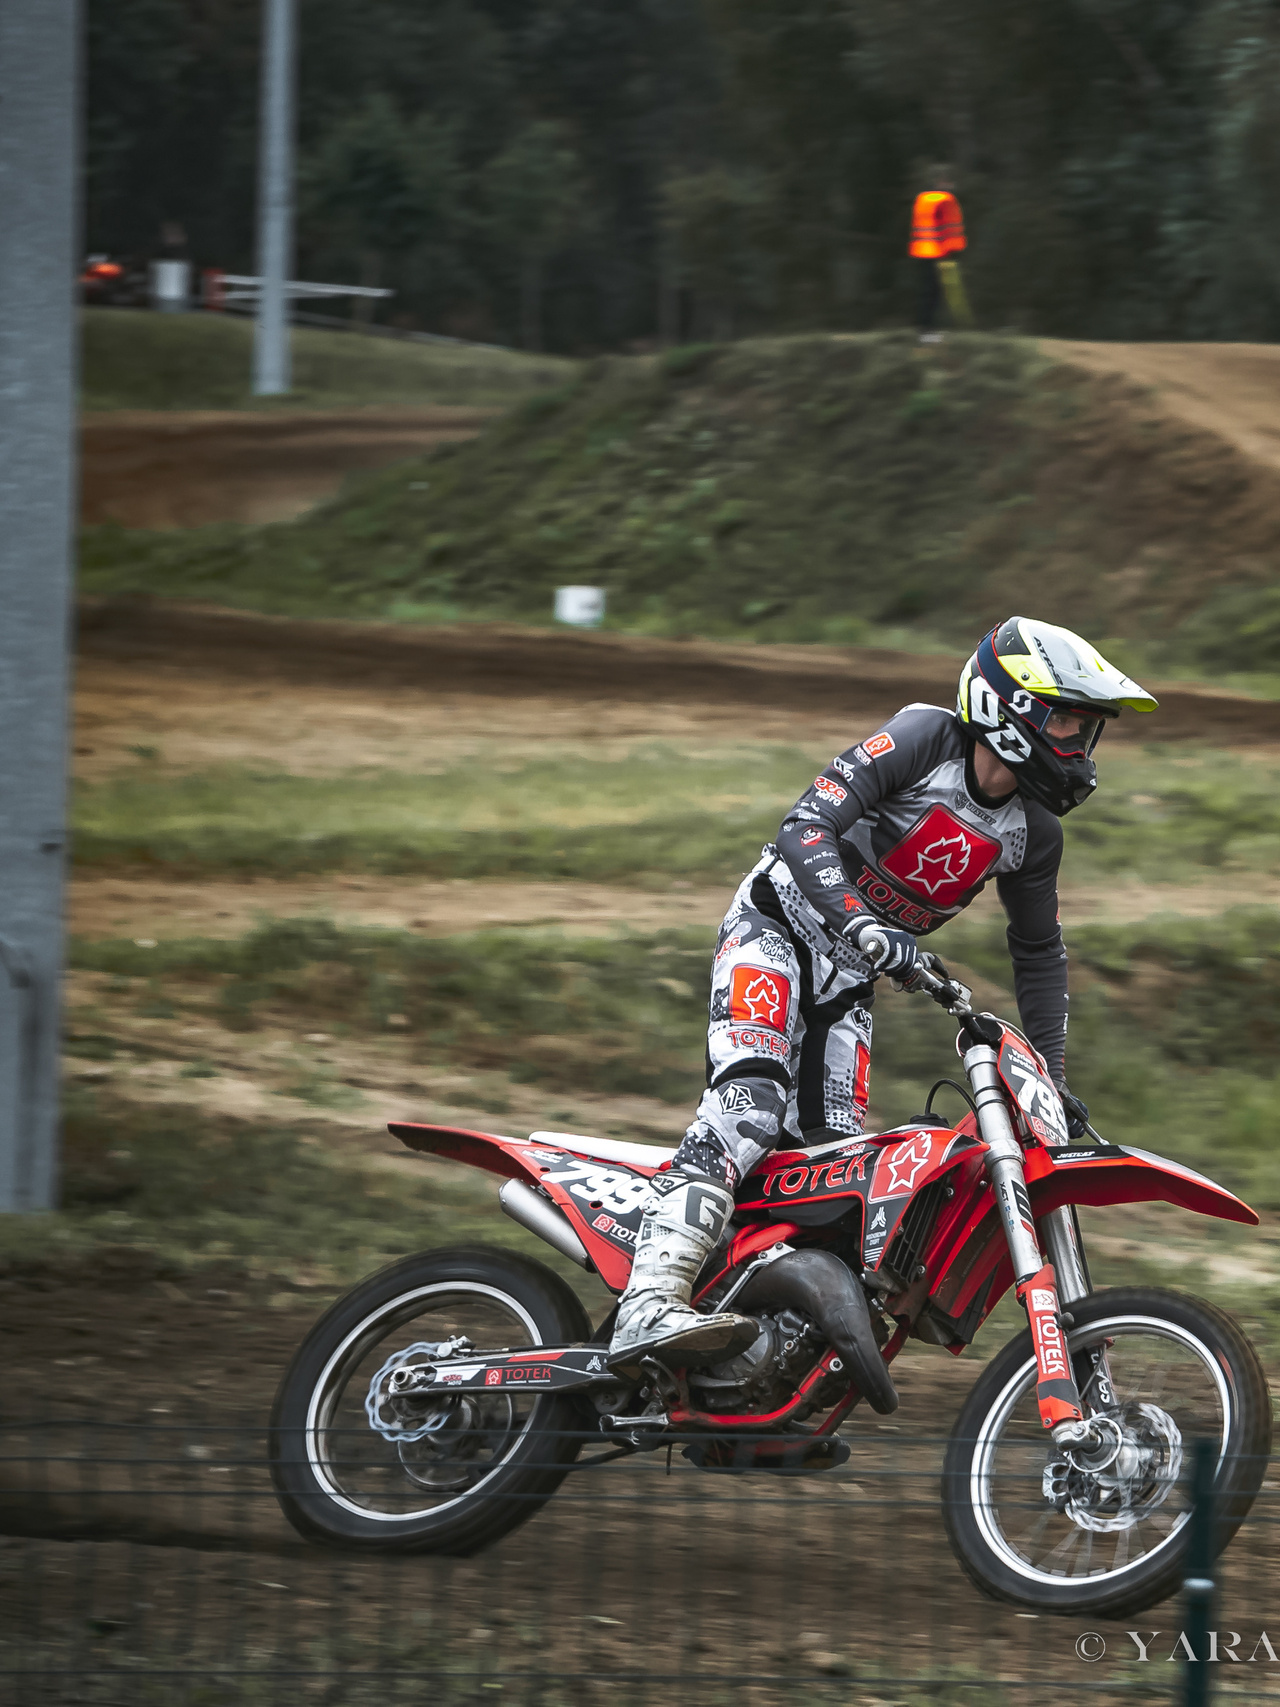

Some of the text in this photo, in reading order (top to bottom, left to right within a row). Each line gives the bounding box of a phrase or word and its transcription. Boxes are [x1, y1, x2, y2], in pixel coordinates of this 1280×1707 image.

[815, 789, 842, 807] MOTO
[856, 865, 941, 929] TOTEK
[726, 1030, 790, 1057] TOTEK
[1010, 1064, 1069, 1143] 799
[540, 1159, 652, 1215] 799
[763, 1151, 875, 1196] TOTEK
[610, 1223, 639, 1244] TOT
[1040, 1315, 1066, 1375] TOTEK
[505, 1367, 552, 1380] TOTEK
